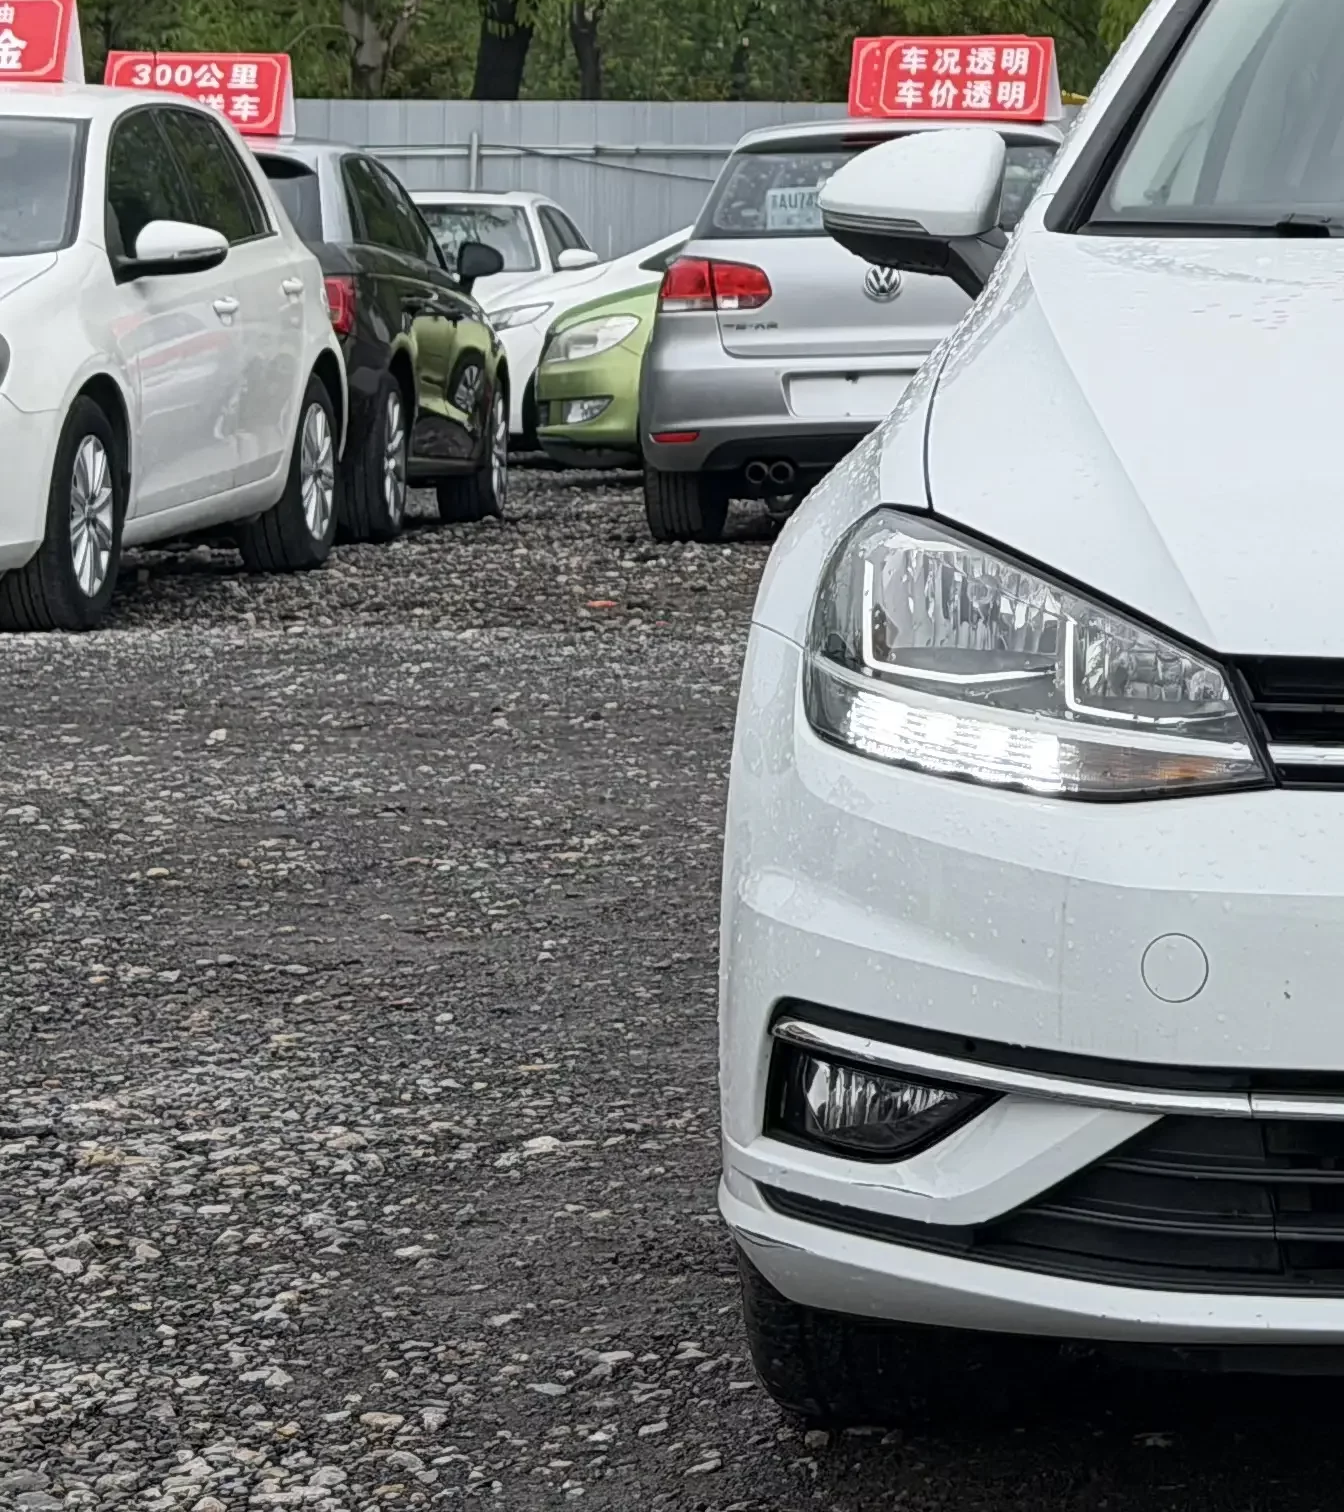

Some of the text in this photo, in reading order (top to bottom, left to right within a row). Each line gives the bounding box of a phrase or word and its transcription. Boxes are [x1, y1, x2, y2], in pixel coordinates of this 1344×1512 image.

[898, 46, 1030, 76] 车况透明
[131, 63, 259, 89] 300公里
[895, 79, 1026, 108] 车价透明
